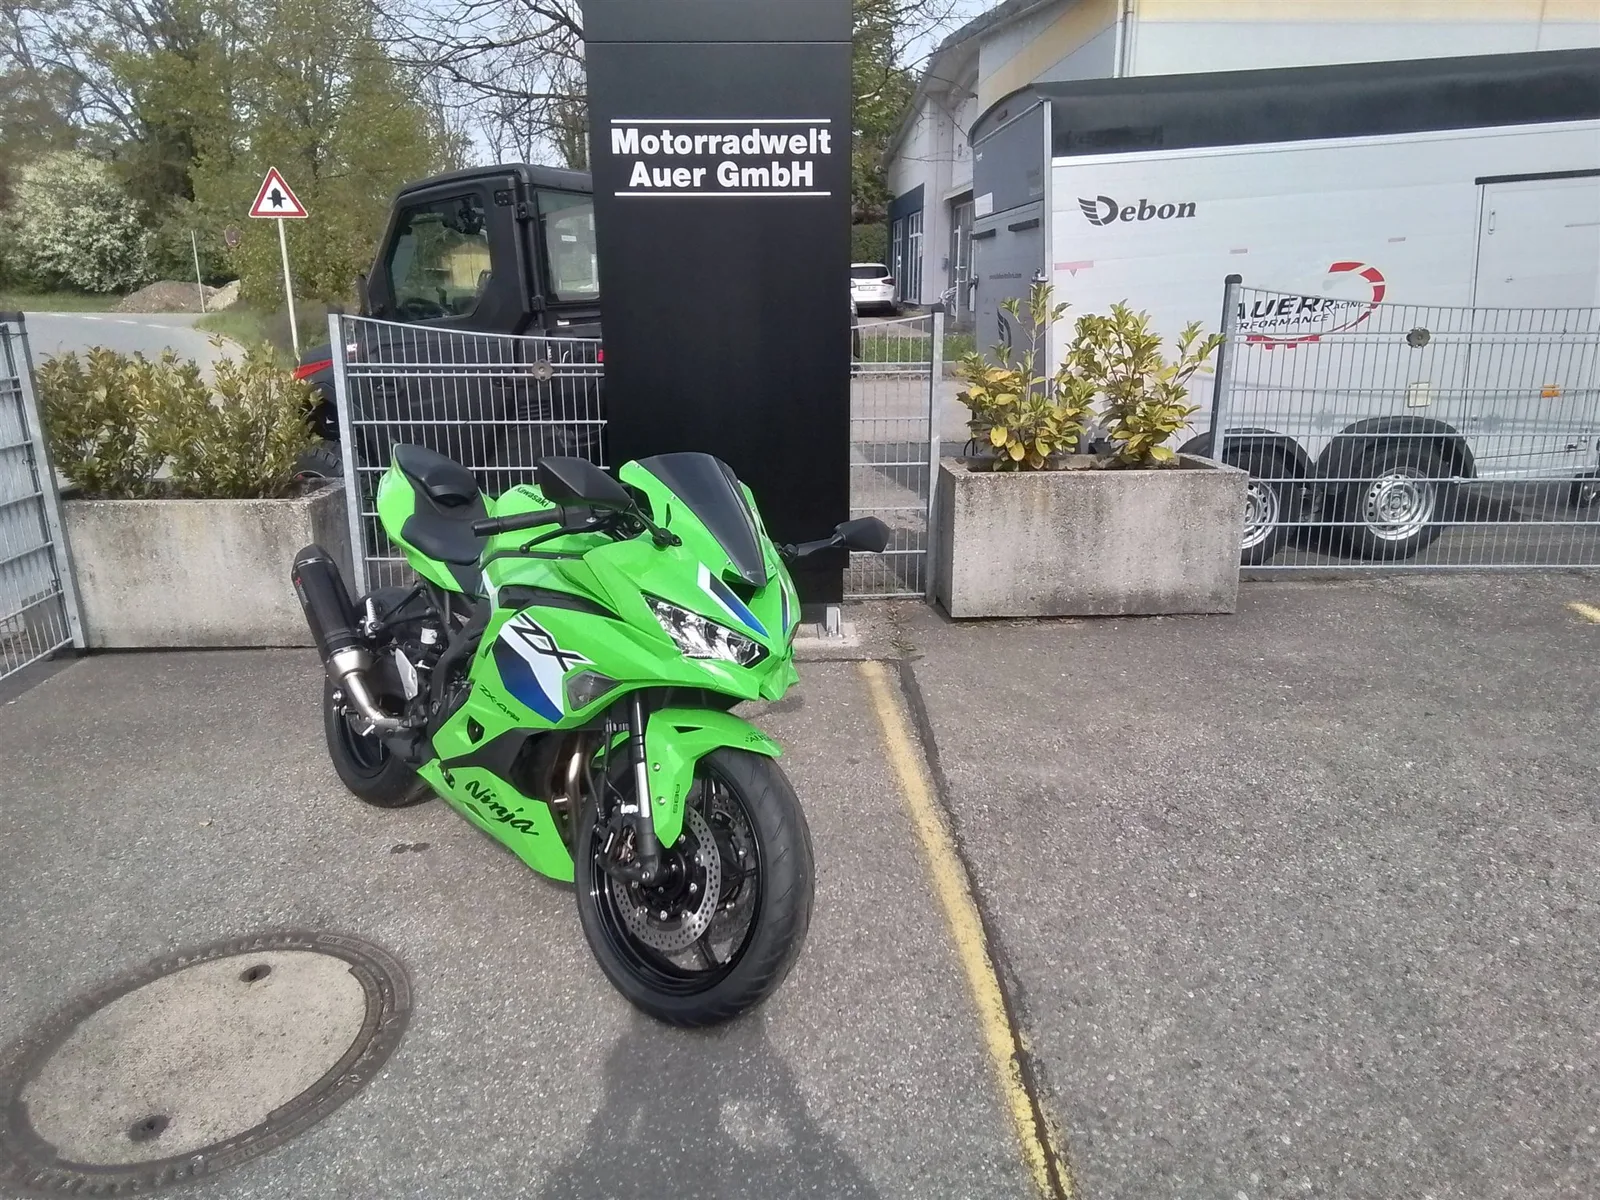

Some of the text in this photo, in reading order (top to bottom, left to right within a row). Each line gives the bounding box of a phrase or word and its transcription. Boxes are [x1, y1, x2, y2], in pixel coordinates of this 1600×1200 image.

[611, 128, 832, 154] Motorradwelt
[629, 161, 813, 187] Auer GmbH
[1078, 195, 1197, 226] Debon
[1235, 313, 1331, 331] ERFORMANCE
[508, 612, 588, 673] ZX
[465, 780, 540, 836] Ninja
